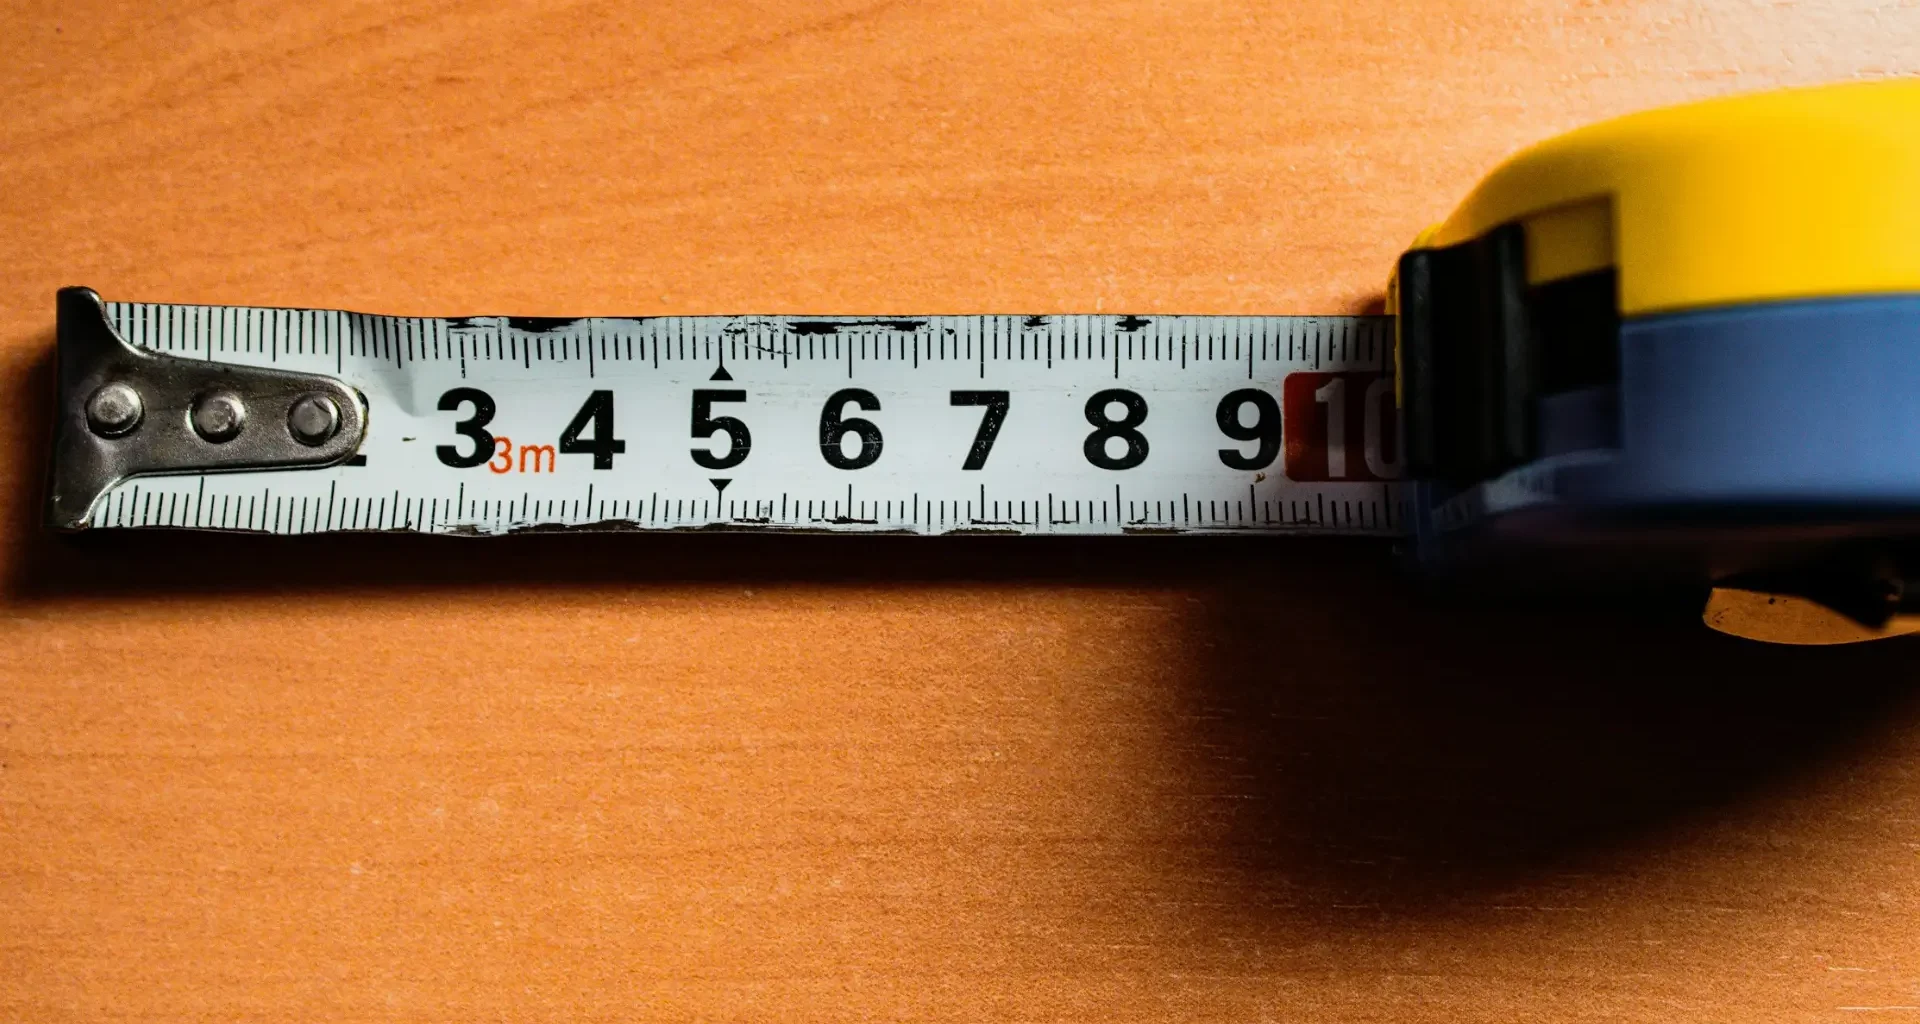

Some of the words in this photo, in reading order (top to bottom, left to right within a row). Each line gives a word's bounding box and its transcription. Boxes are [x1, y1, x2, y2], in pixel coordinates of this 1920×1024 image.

[436, 387, 496, 468] 3
[558, 390, 626, 470] 4
[690, 389, 752, 470] 5
[819, 388, 884, 471] 6
[949, 390, 1010, 471] 7
[1083, 388, 1150, 470] 8
[1215, 388, 1283, 471] 9
[1315, 376, 1405, 480] 10
[488, 436, 556, 475] 3m
